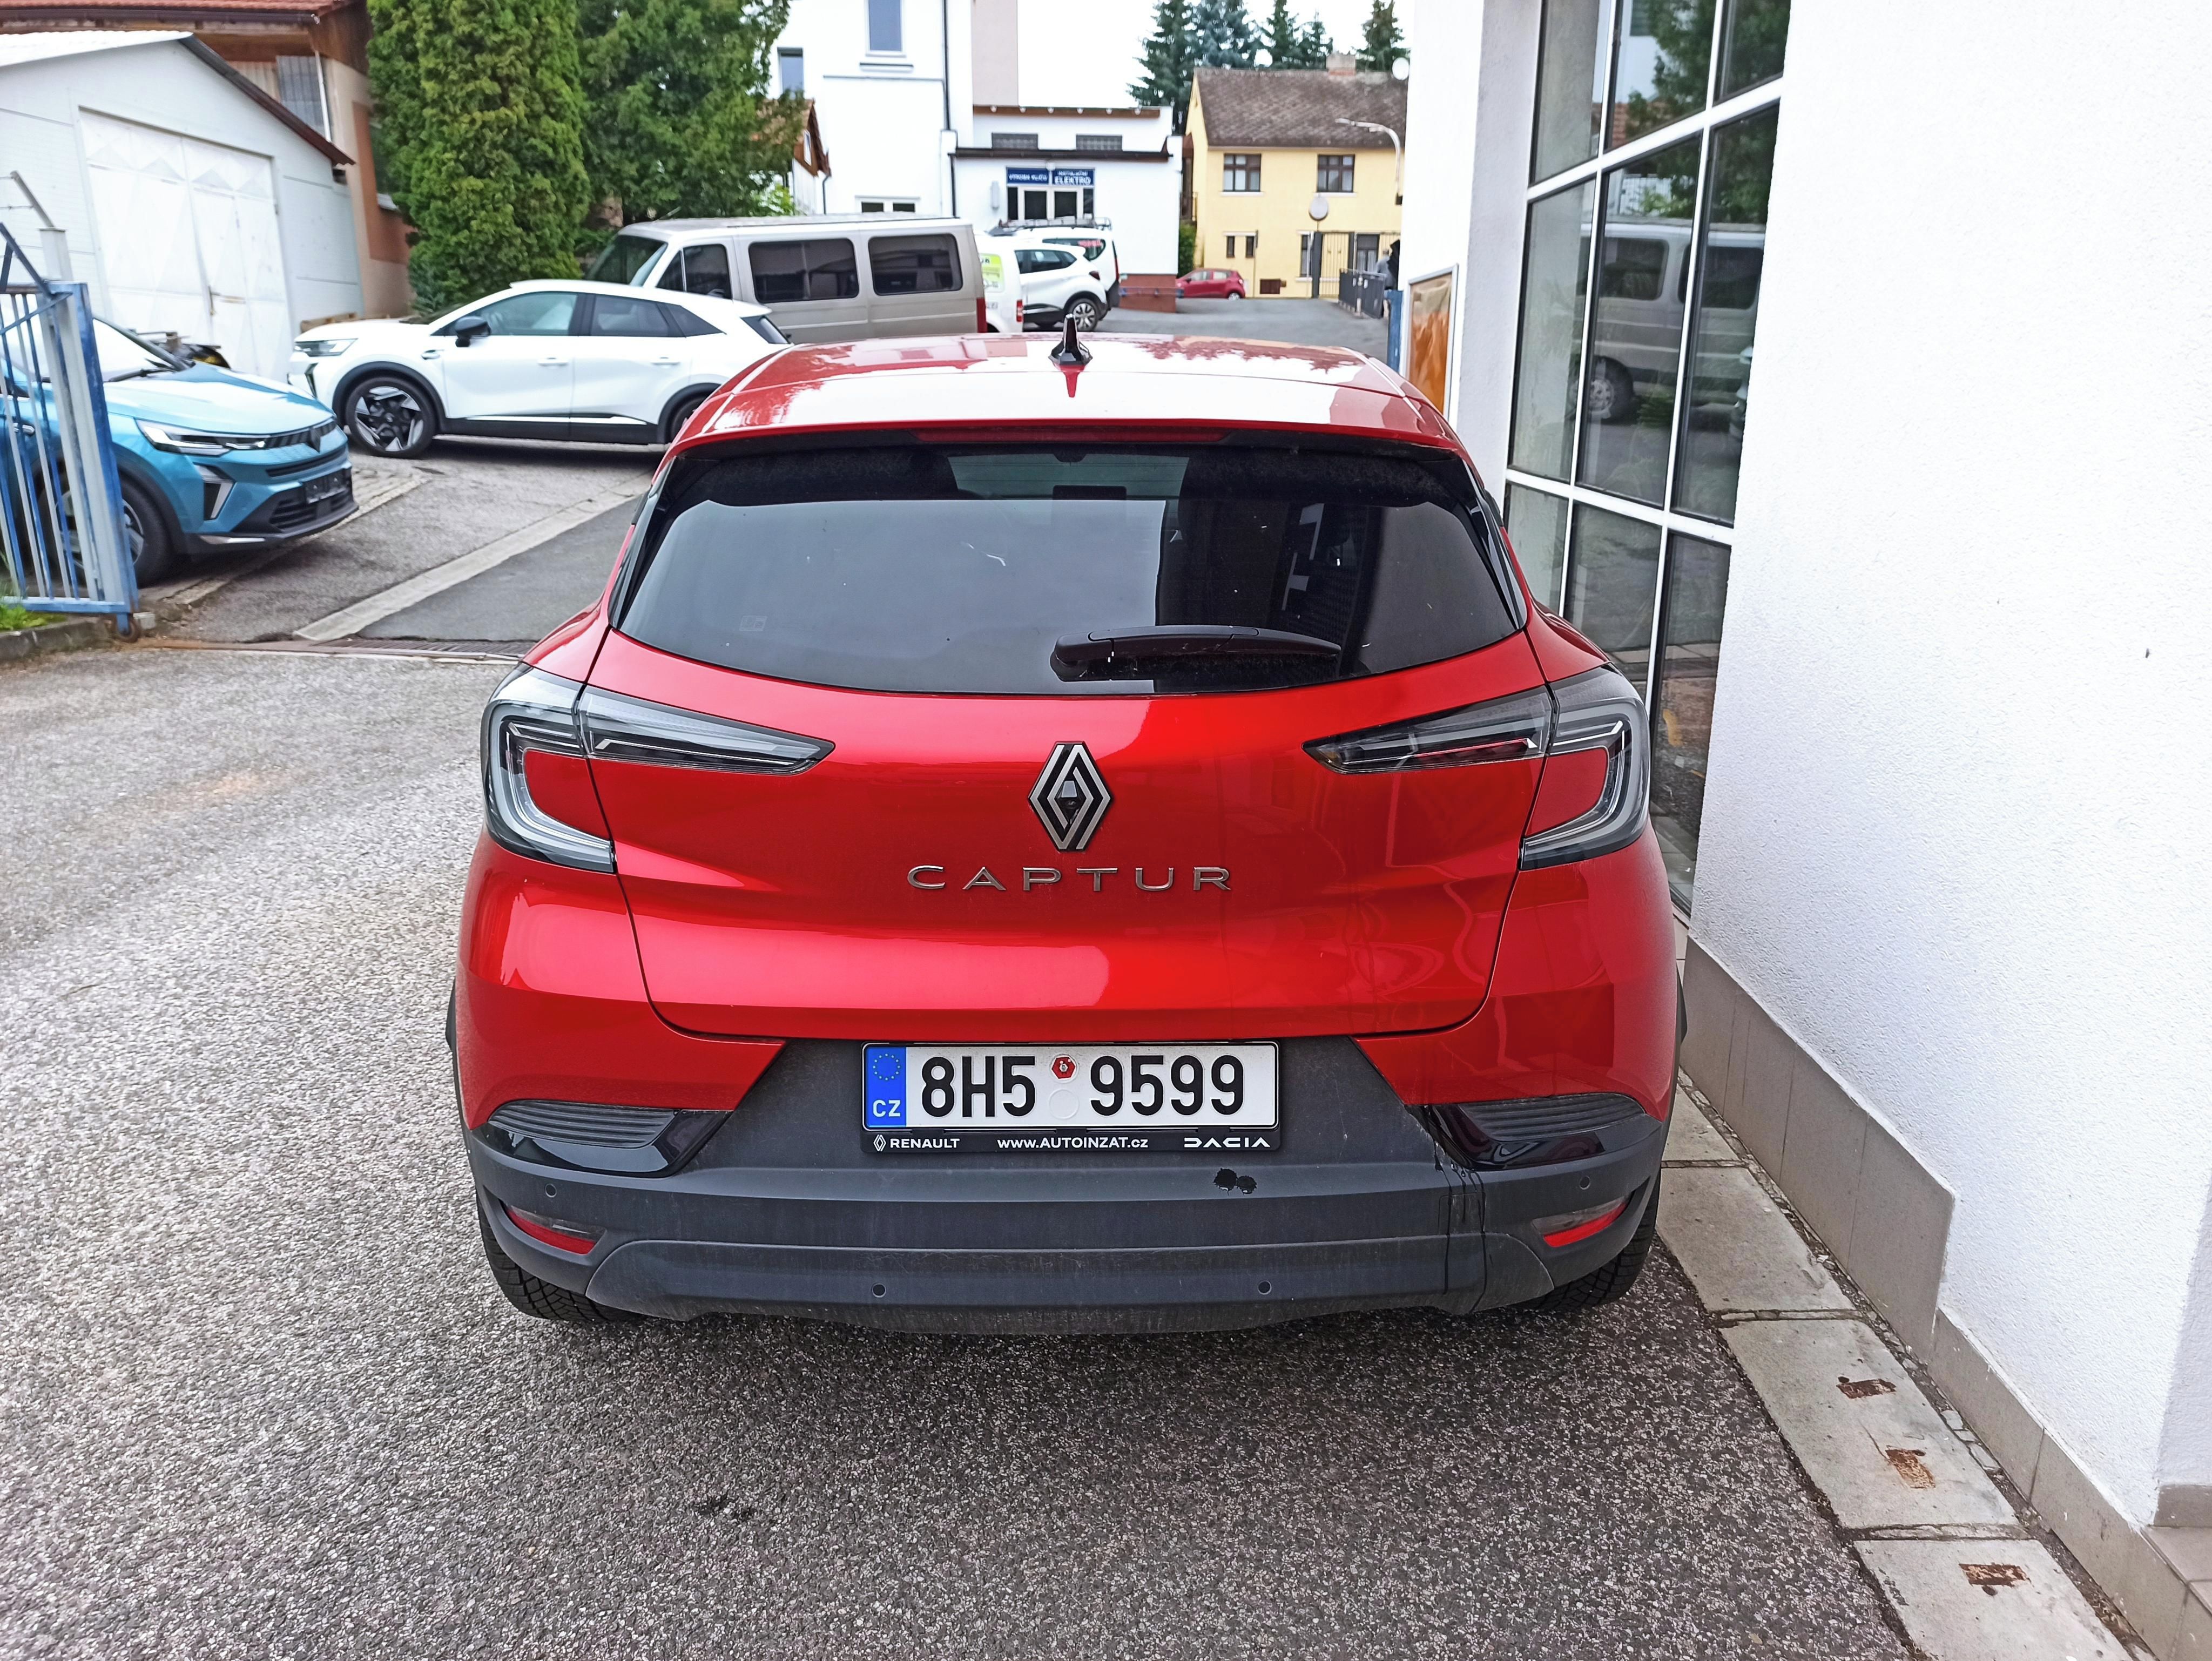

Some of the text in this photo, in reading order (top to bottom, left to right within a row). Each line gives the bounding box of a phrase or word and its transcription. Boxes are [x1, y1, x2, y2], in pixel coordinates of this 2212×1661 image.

[1055, 176, 1092, 185] ELEKTRO
[907, 865, 1231, 891] CAPTUR
[922, 1055, 1244, 1118] 8H5 9599
[873, 1100, 900, 1117] CZ
[890, 1138, 960, 1149] RENAULT
[997, 1137, 1148, 1149] www.AUTOINZAT.cz
[1184, 1137, 1271, 1148] DACIA
